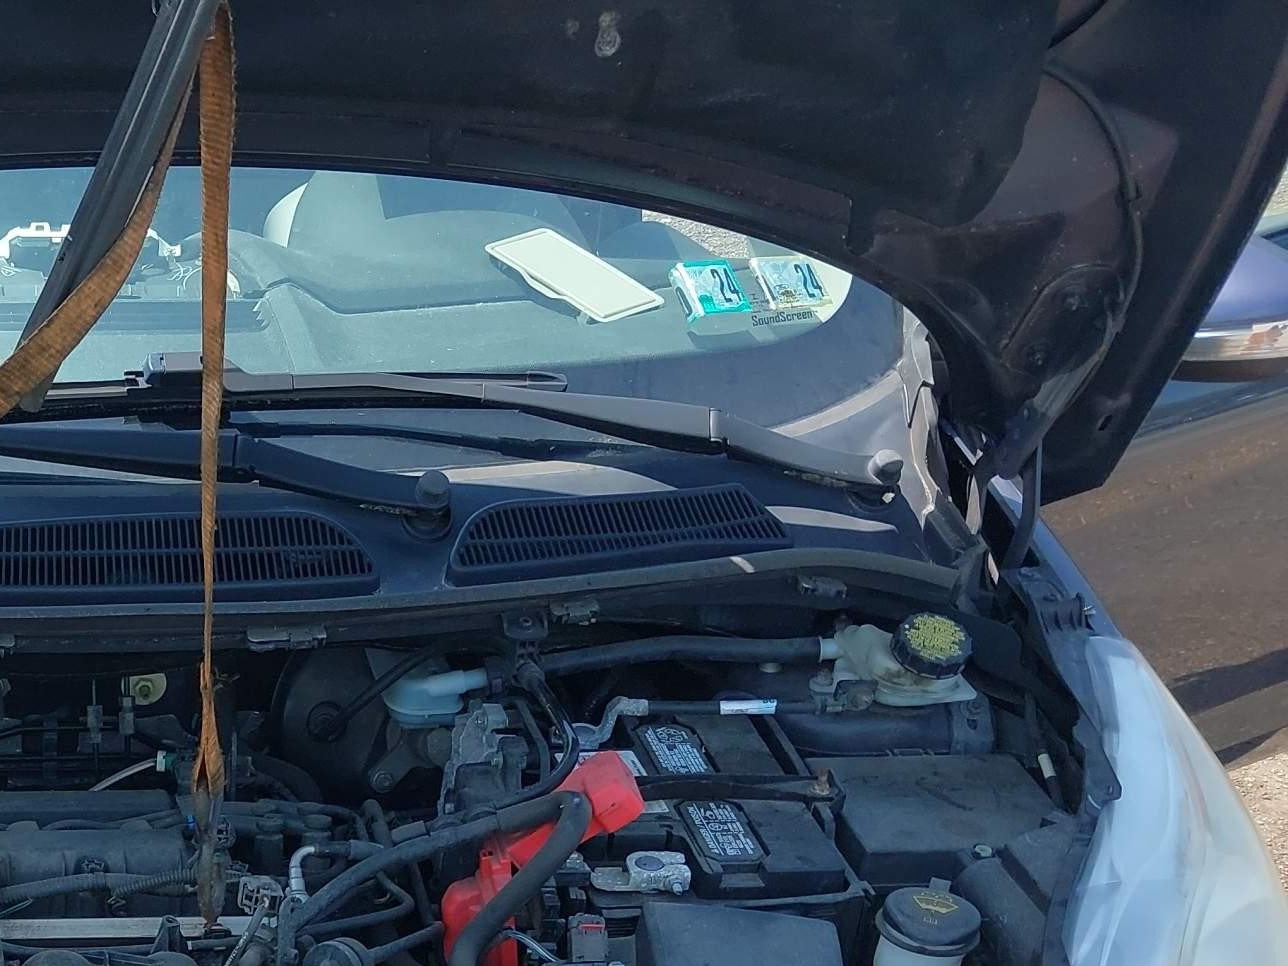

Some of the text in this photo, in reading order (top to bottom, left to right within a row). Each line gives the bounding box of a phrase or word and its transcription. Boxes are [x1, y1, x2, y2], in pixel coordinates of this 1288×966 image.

[710, 268, 743, 303] 24
[793, 263, 825, 298] 24
[751, 310, 813, 327] SoundScreen
